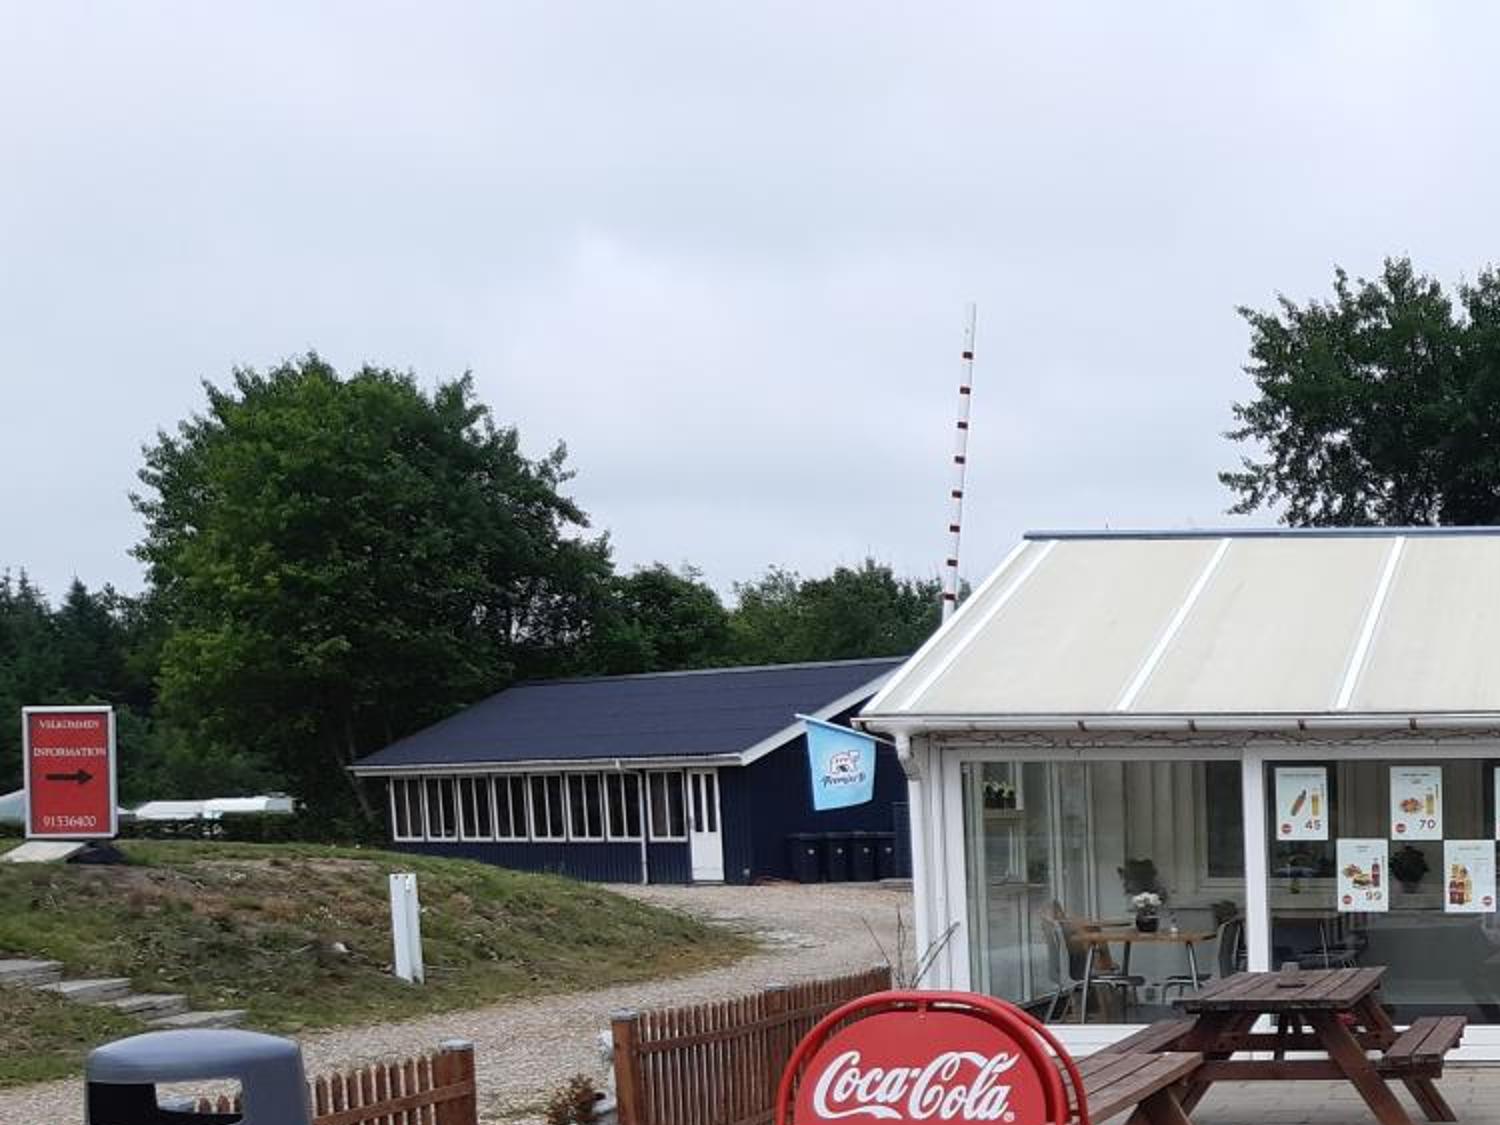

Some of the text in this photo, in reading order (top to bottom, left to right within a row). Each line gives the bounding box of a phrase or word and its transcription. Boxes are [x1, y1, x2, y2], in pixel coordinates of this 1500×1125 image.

[33, 747, 106, 757] INFORMATION
[1305, 820, 1321, 831] 45
[1419, 819, 1436, 830] 70
[813, 1050, 1020, 1120] Coca-Cola
